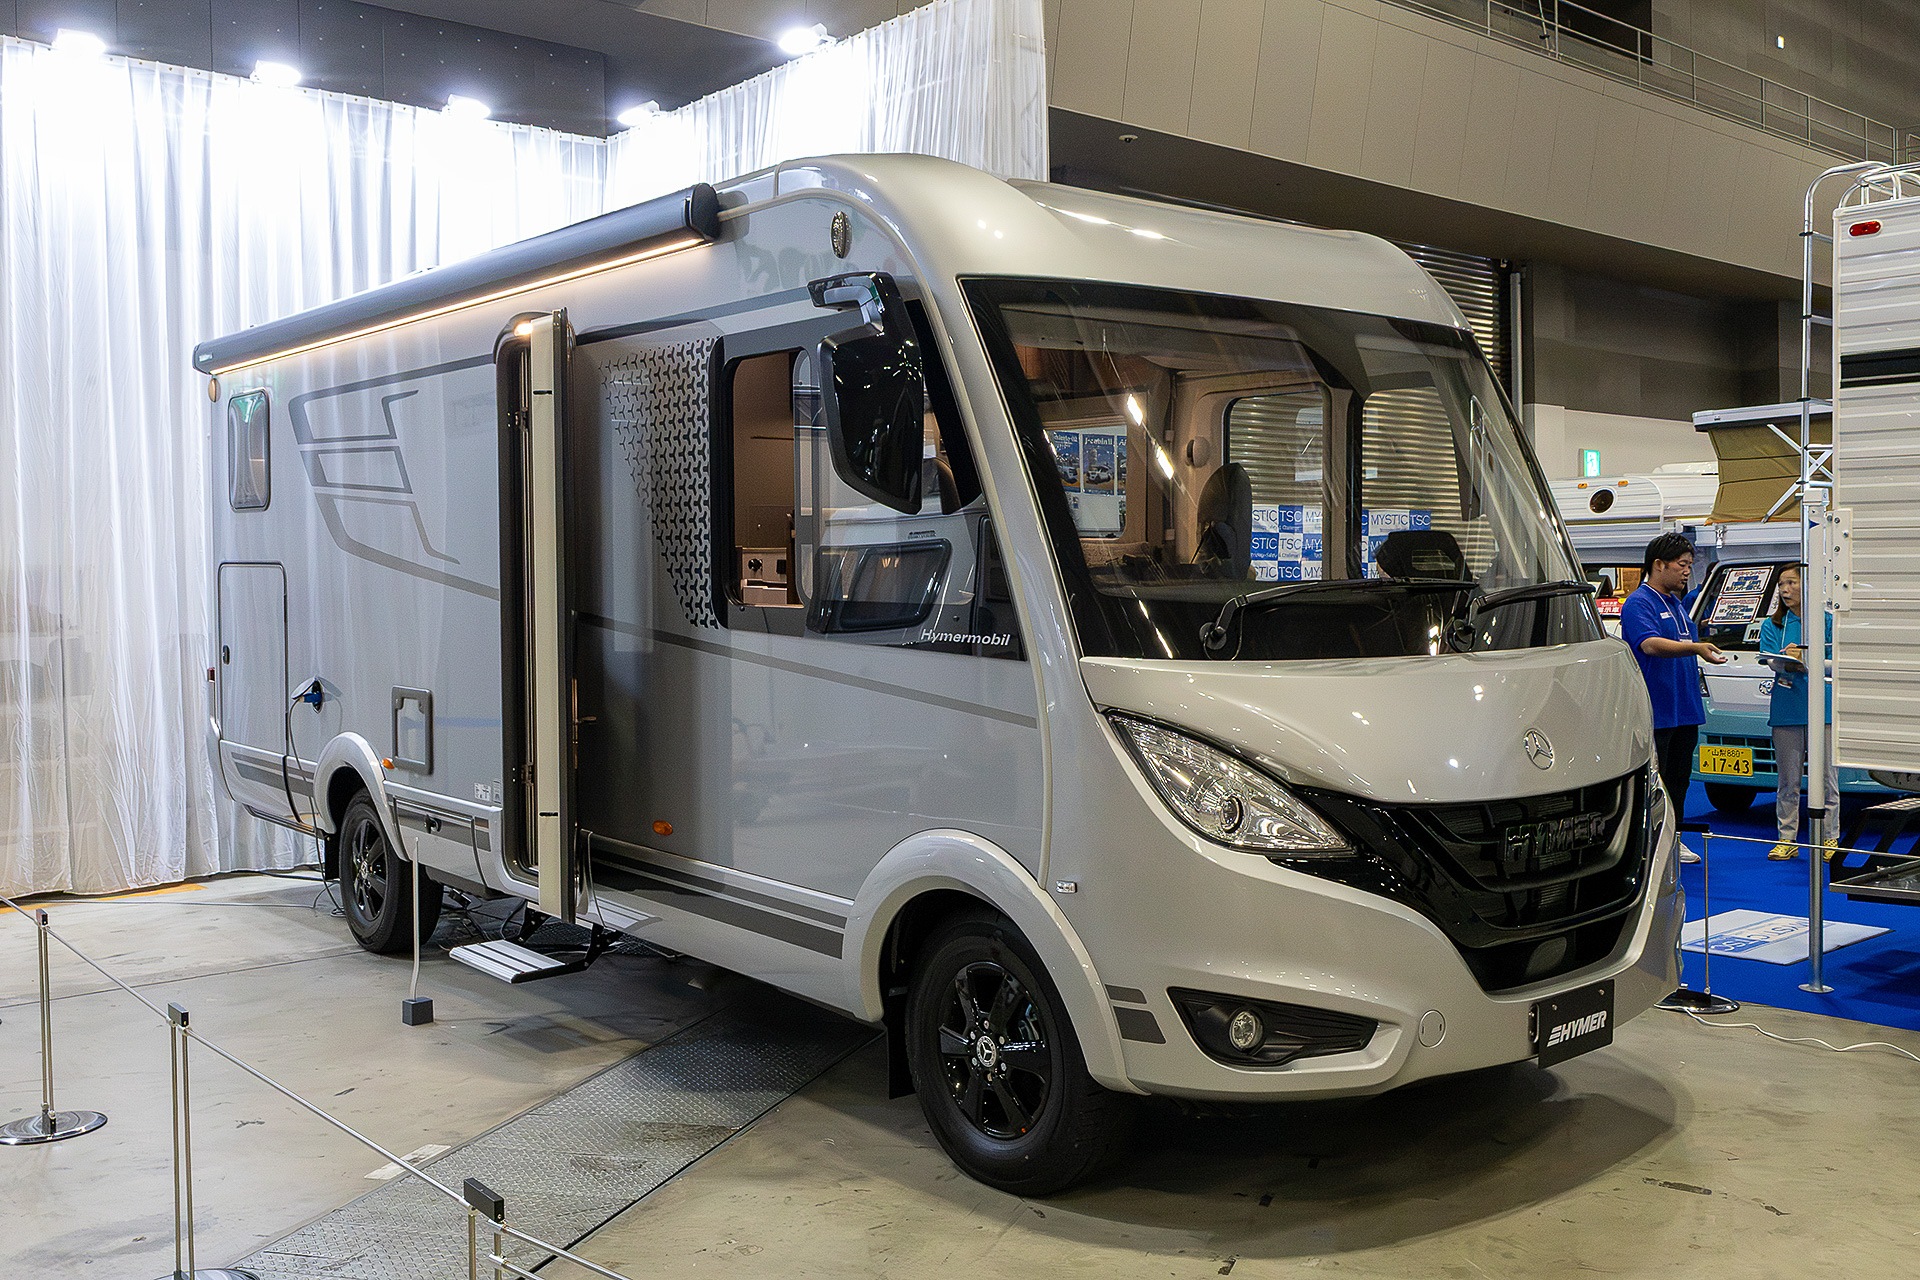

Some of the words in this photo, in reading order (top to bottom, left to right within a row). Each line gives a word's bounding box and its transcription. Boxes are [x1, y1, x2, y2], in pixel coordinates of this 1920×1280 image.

[1279, 510, 1302, 522] TSC
[1371, 513, 1409, 526] MYSTIC
[1410, 514, 1431, 526] TSC
[1280, 538, 1302, 550] TSC
[1305, 538, 1322, 550] MY
[1279, 566, 1301, 579] TSC
[1304, 566, 1322, 578] MY
[920, 628, 1011, 646] Hymermobil
[1712, 758, 1750, 774] 17-43
[1505, 811, 1606, 860] HYMER
[1557, 1010, 1608, 1043] HYMER
